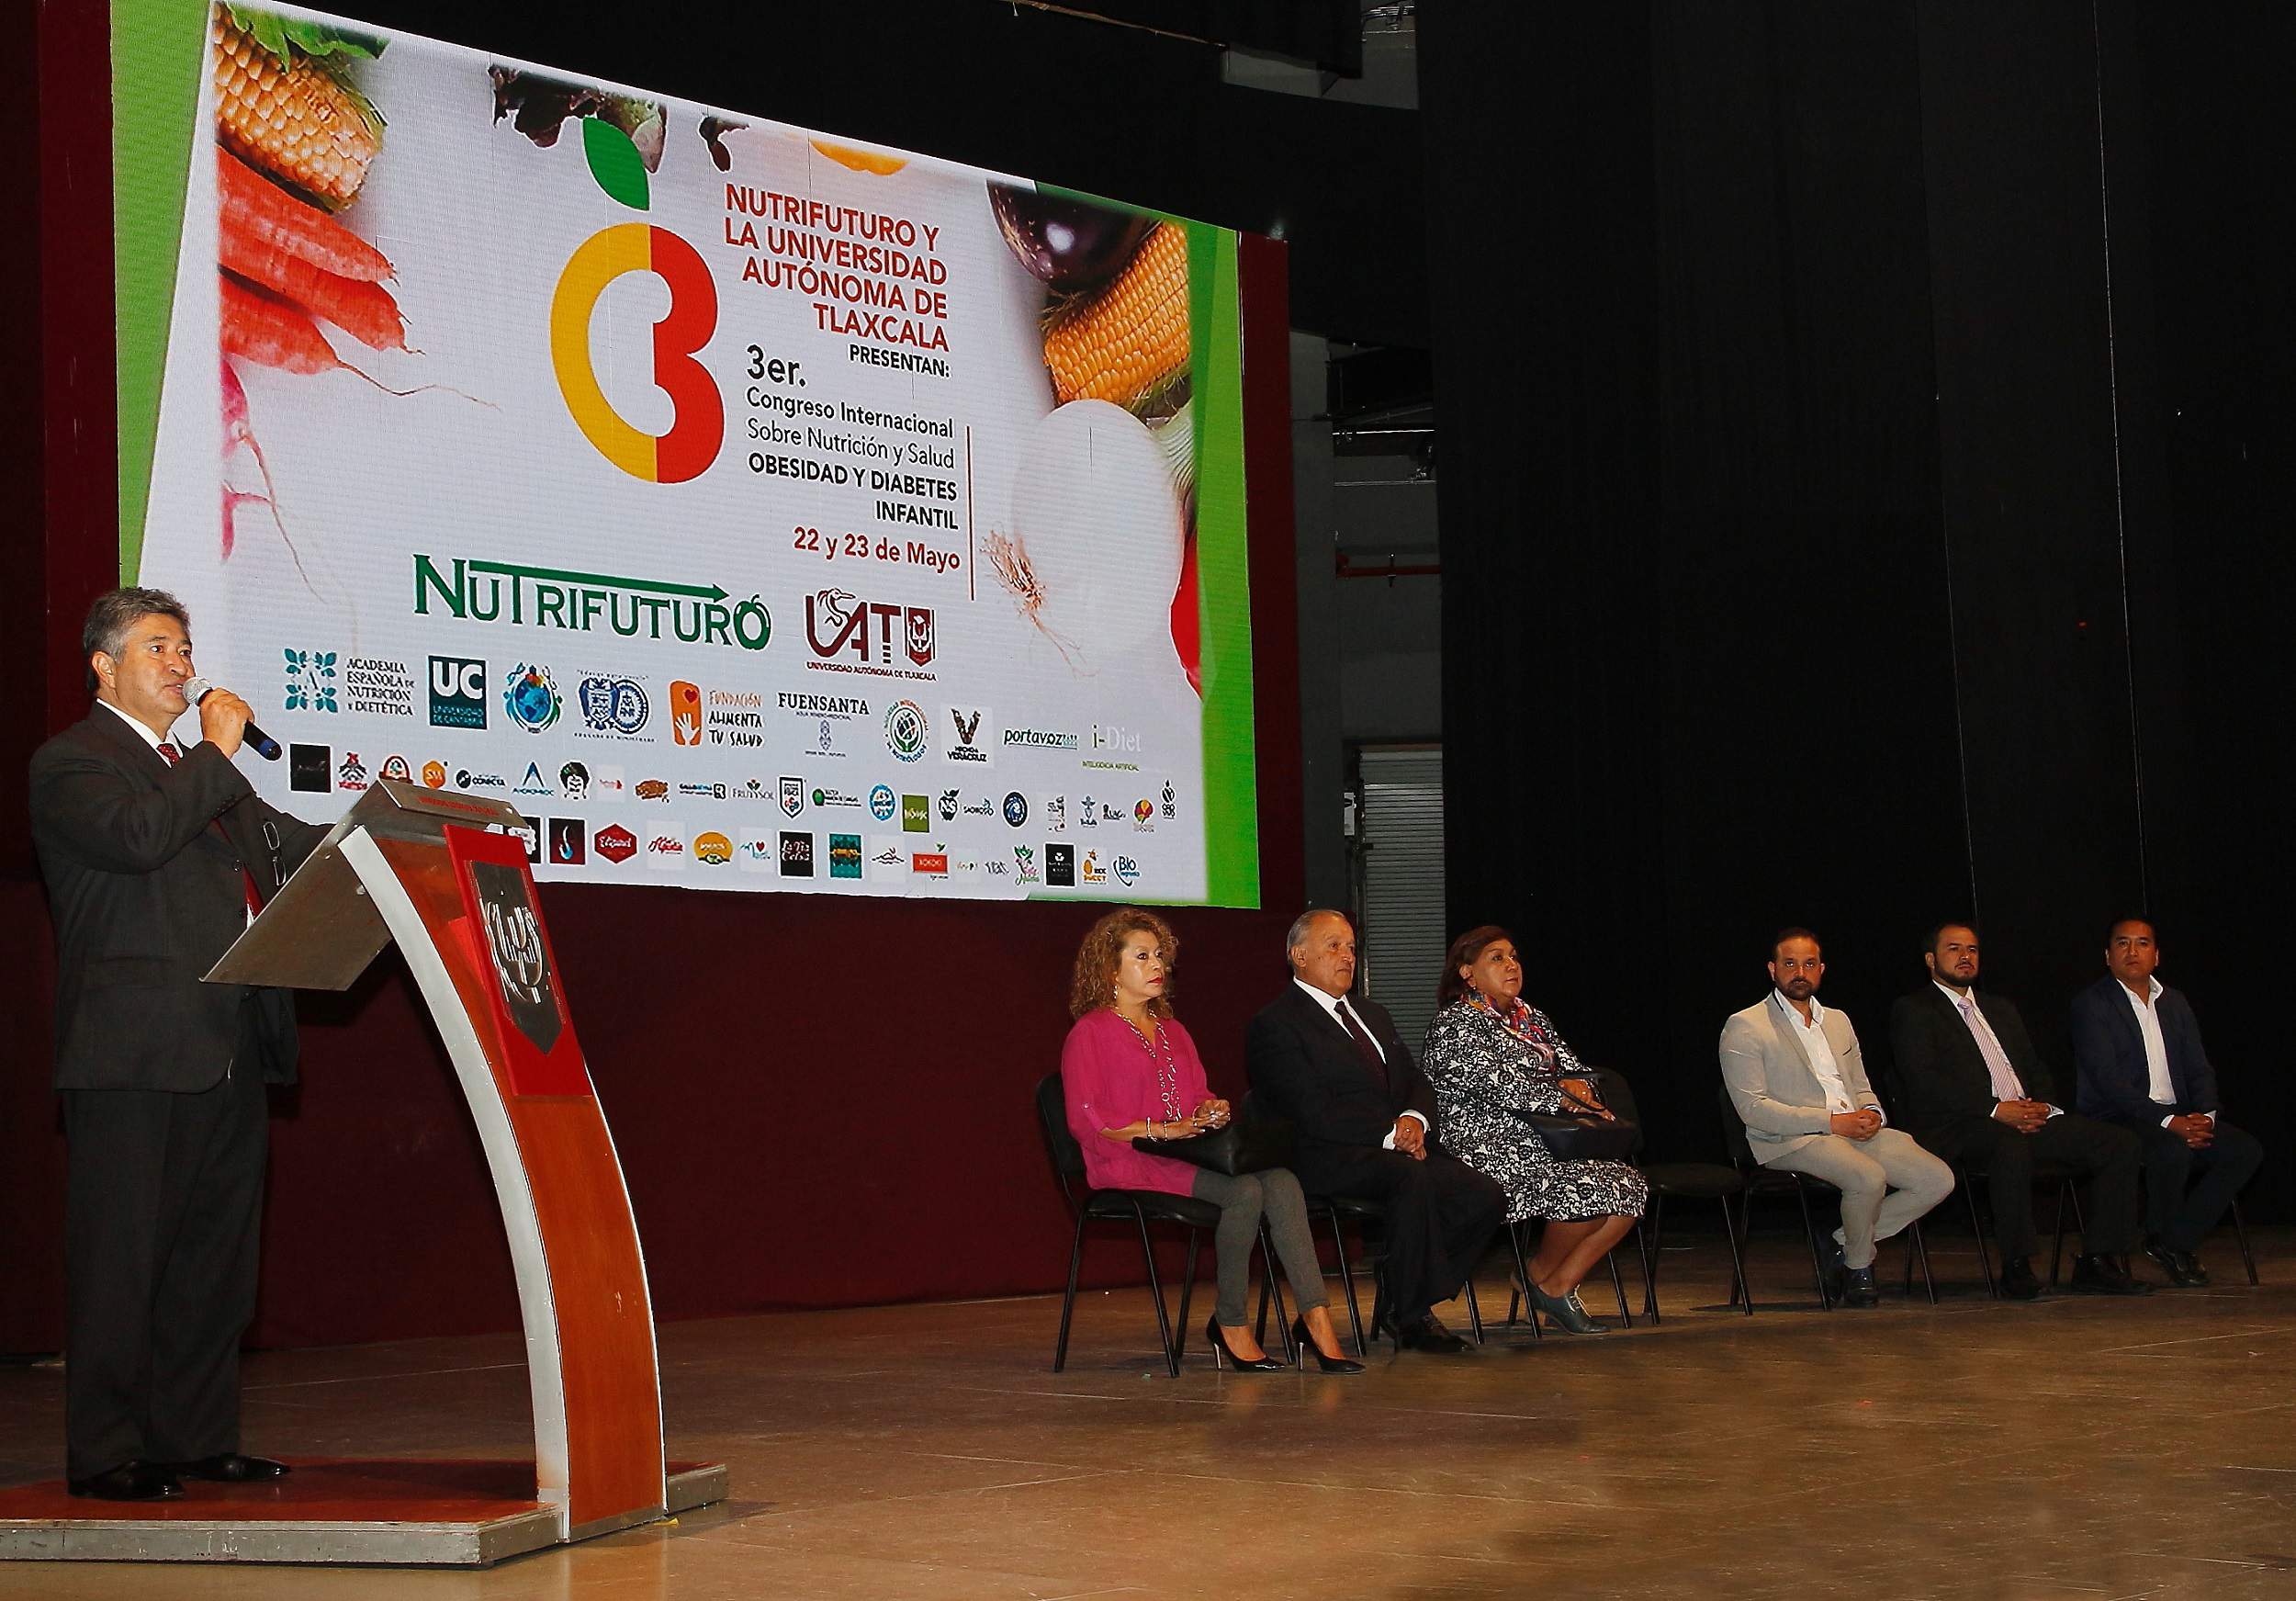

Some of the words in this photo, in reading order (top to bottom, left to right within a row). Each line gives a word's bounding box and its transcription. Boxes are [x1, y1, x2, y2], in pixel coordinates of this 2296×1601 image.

[726, 184, 916, 246] NUTRIFUTURO
[922, 224, 939, 251] Y
[726, 217, 759, 249] LA
[768, 226, 947, 285] UNIVERSIDAD
[742, 256, 906, 311] AUTÓNOMA
[915, 288, 947, 319] DE
[813, 303, 949, 352] TLAXCALA
[747, 344, 805, 387] 3er.
[850, 344, 950, 377] PRESENTAN:
[747, 386, 835, 418] Congreso
[841, 402, 953, 437] Internacional
[748, 418, 802, 445] Sobre
[807, 427, 888, 459] Nutrición
[894, 446, 903, 466] y
[908, 443, 954, 469] Salud
[748, 452, 848, 484] OBESIDAD
[853, 468, 865, 488] Y
[872, 470, 957, 501] DIABETES
[876, 501, 959, 529] INFANTIL
[794, 526, 818, 551] 22
[826, 537, 838, 559] y
[845, 534, 869, 557] 23
[875, 537, 900, 561] de
[907, 541, 961, 573] Mayo
[347, 658, 406, 673] ACADEMIA
[433, 660, 483, 700] UC
[708, 711, 762, 727] ALIMENTA
[778, 692, 870, 715] FUENSANTA
[709, 729, 724, 745] TU
[729, 731, 763, 747] SALUD
[1004, 728, 1063, 746] portavoz
[1093, 724, 1142, 752] i-Diet
